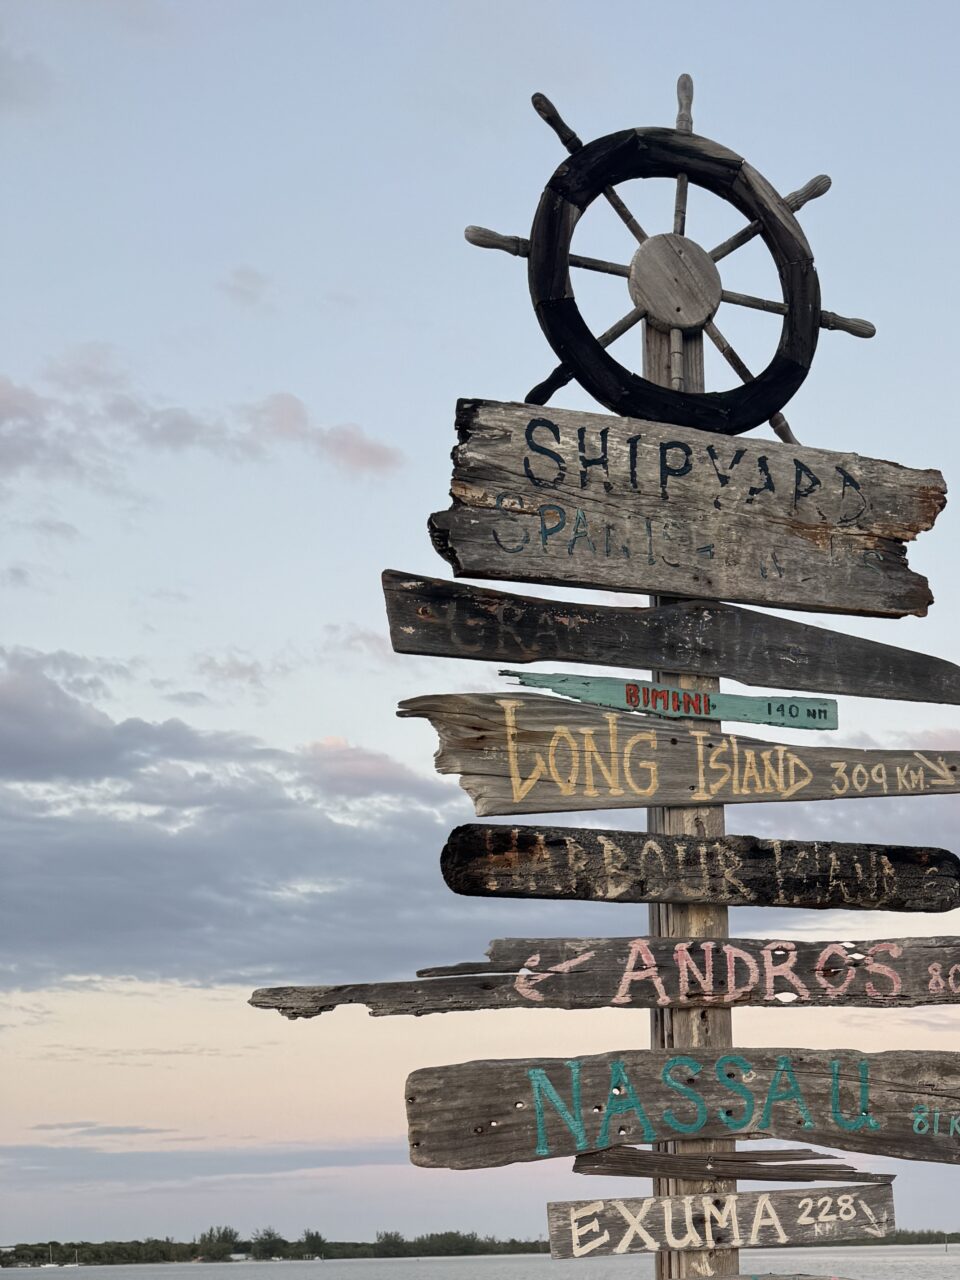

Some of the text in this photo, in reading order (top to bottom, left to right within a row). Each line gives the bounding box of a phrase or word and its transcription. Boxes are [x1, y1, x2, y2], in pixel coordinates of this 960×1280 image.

[767, 703, 799, 718] 140
[806, 708, 828, 720] NM
[494, 699, 660, 802] LONG
[830, 762, 887, 794] 309
[611, 938, 901, 1006] ANDROS
[528, 1056, 881, 1155] NASSAU
[912, 1104, 939, 1136] 81
[570, 1192, 858, 1257] EXUMA 228
[814, 1222, 838, 1236] KM
